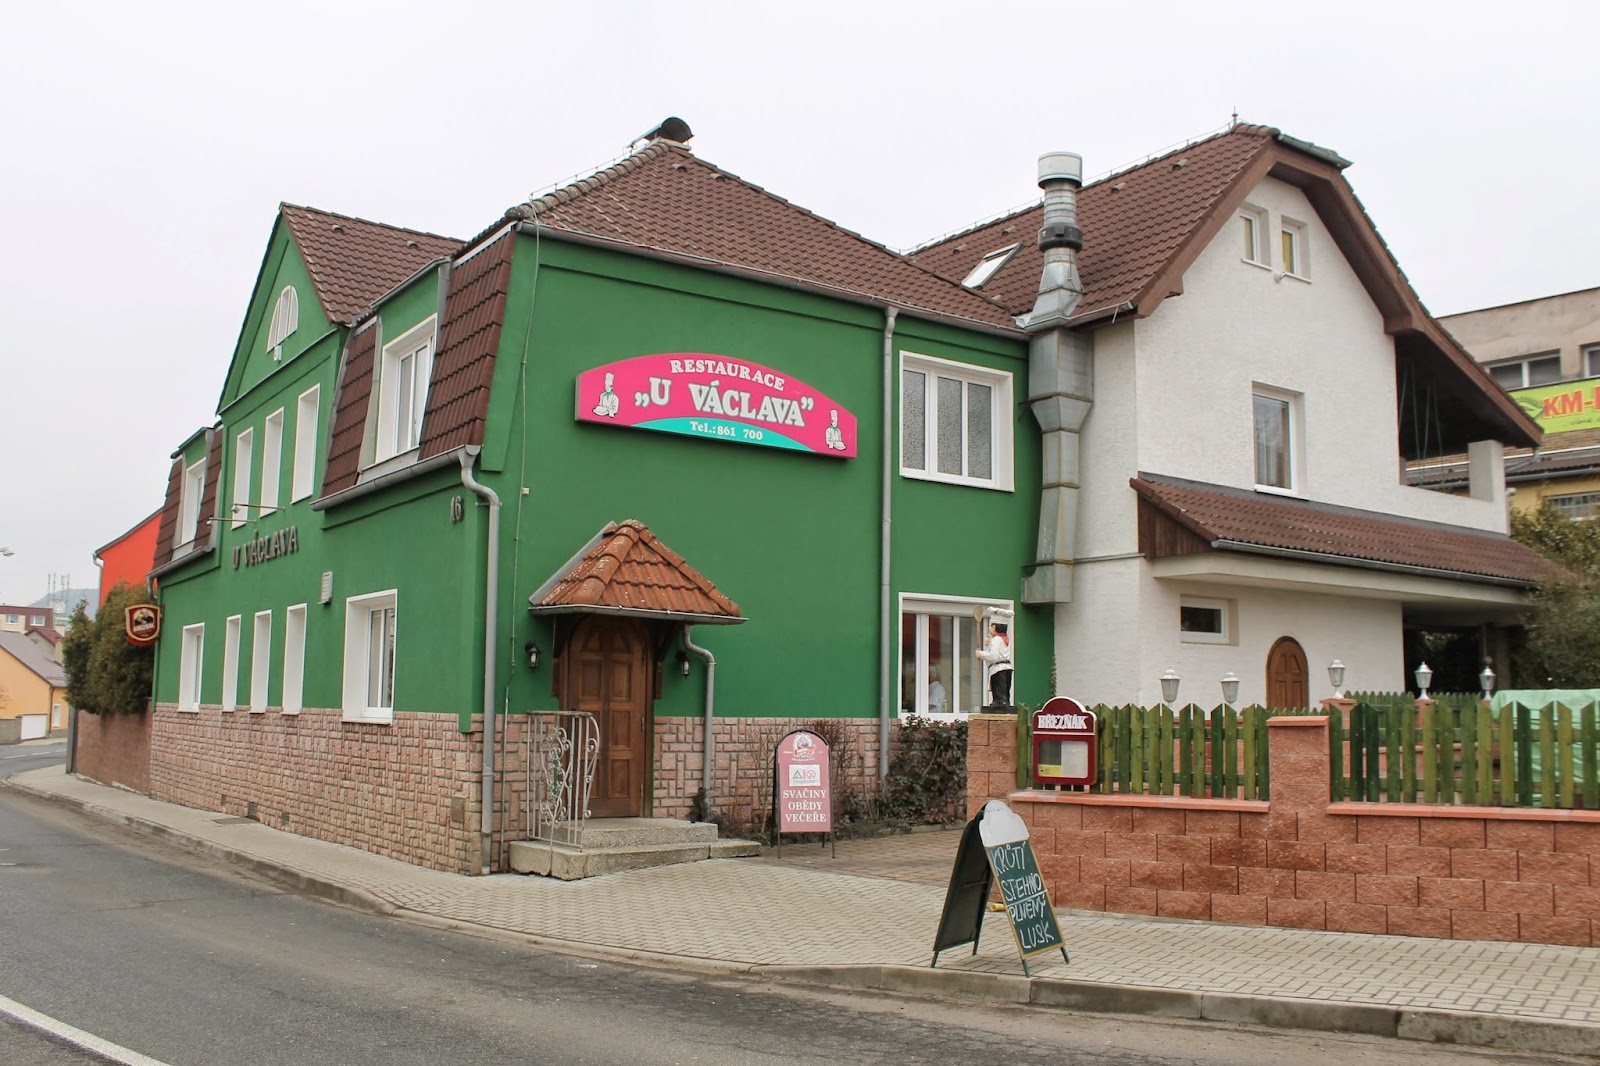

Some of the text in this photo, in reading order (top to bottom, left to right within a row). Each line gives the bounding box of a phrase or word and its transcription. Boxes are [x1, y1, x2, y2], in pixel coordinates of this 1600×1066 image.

[669, 359, 785, 391] RESTAURACE
[743, 428, 763, 440] 700
[450, 495, 462, 522] 16
[232, 525, 299, 570] U VÁCLAVA
[783, 788, 827, 799] SVAČINY
[788, 800, 823, 811] OBĚDY
[785, 811, 827, 823] VEČEŘE
[991, 841, 1026, 876] KRŮTÍ
[1001, 872, 1042, 901] STEHNO
[1020, 920, 1055, 948] LUSK
